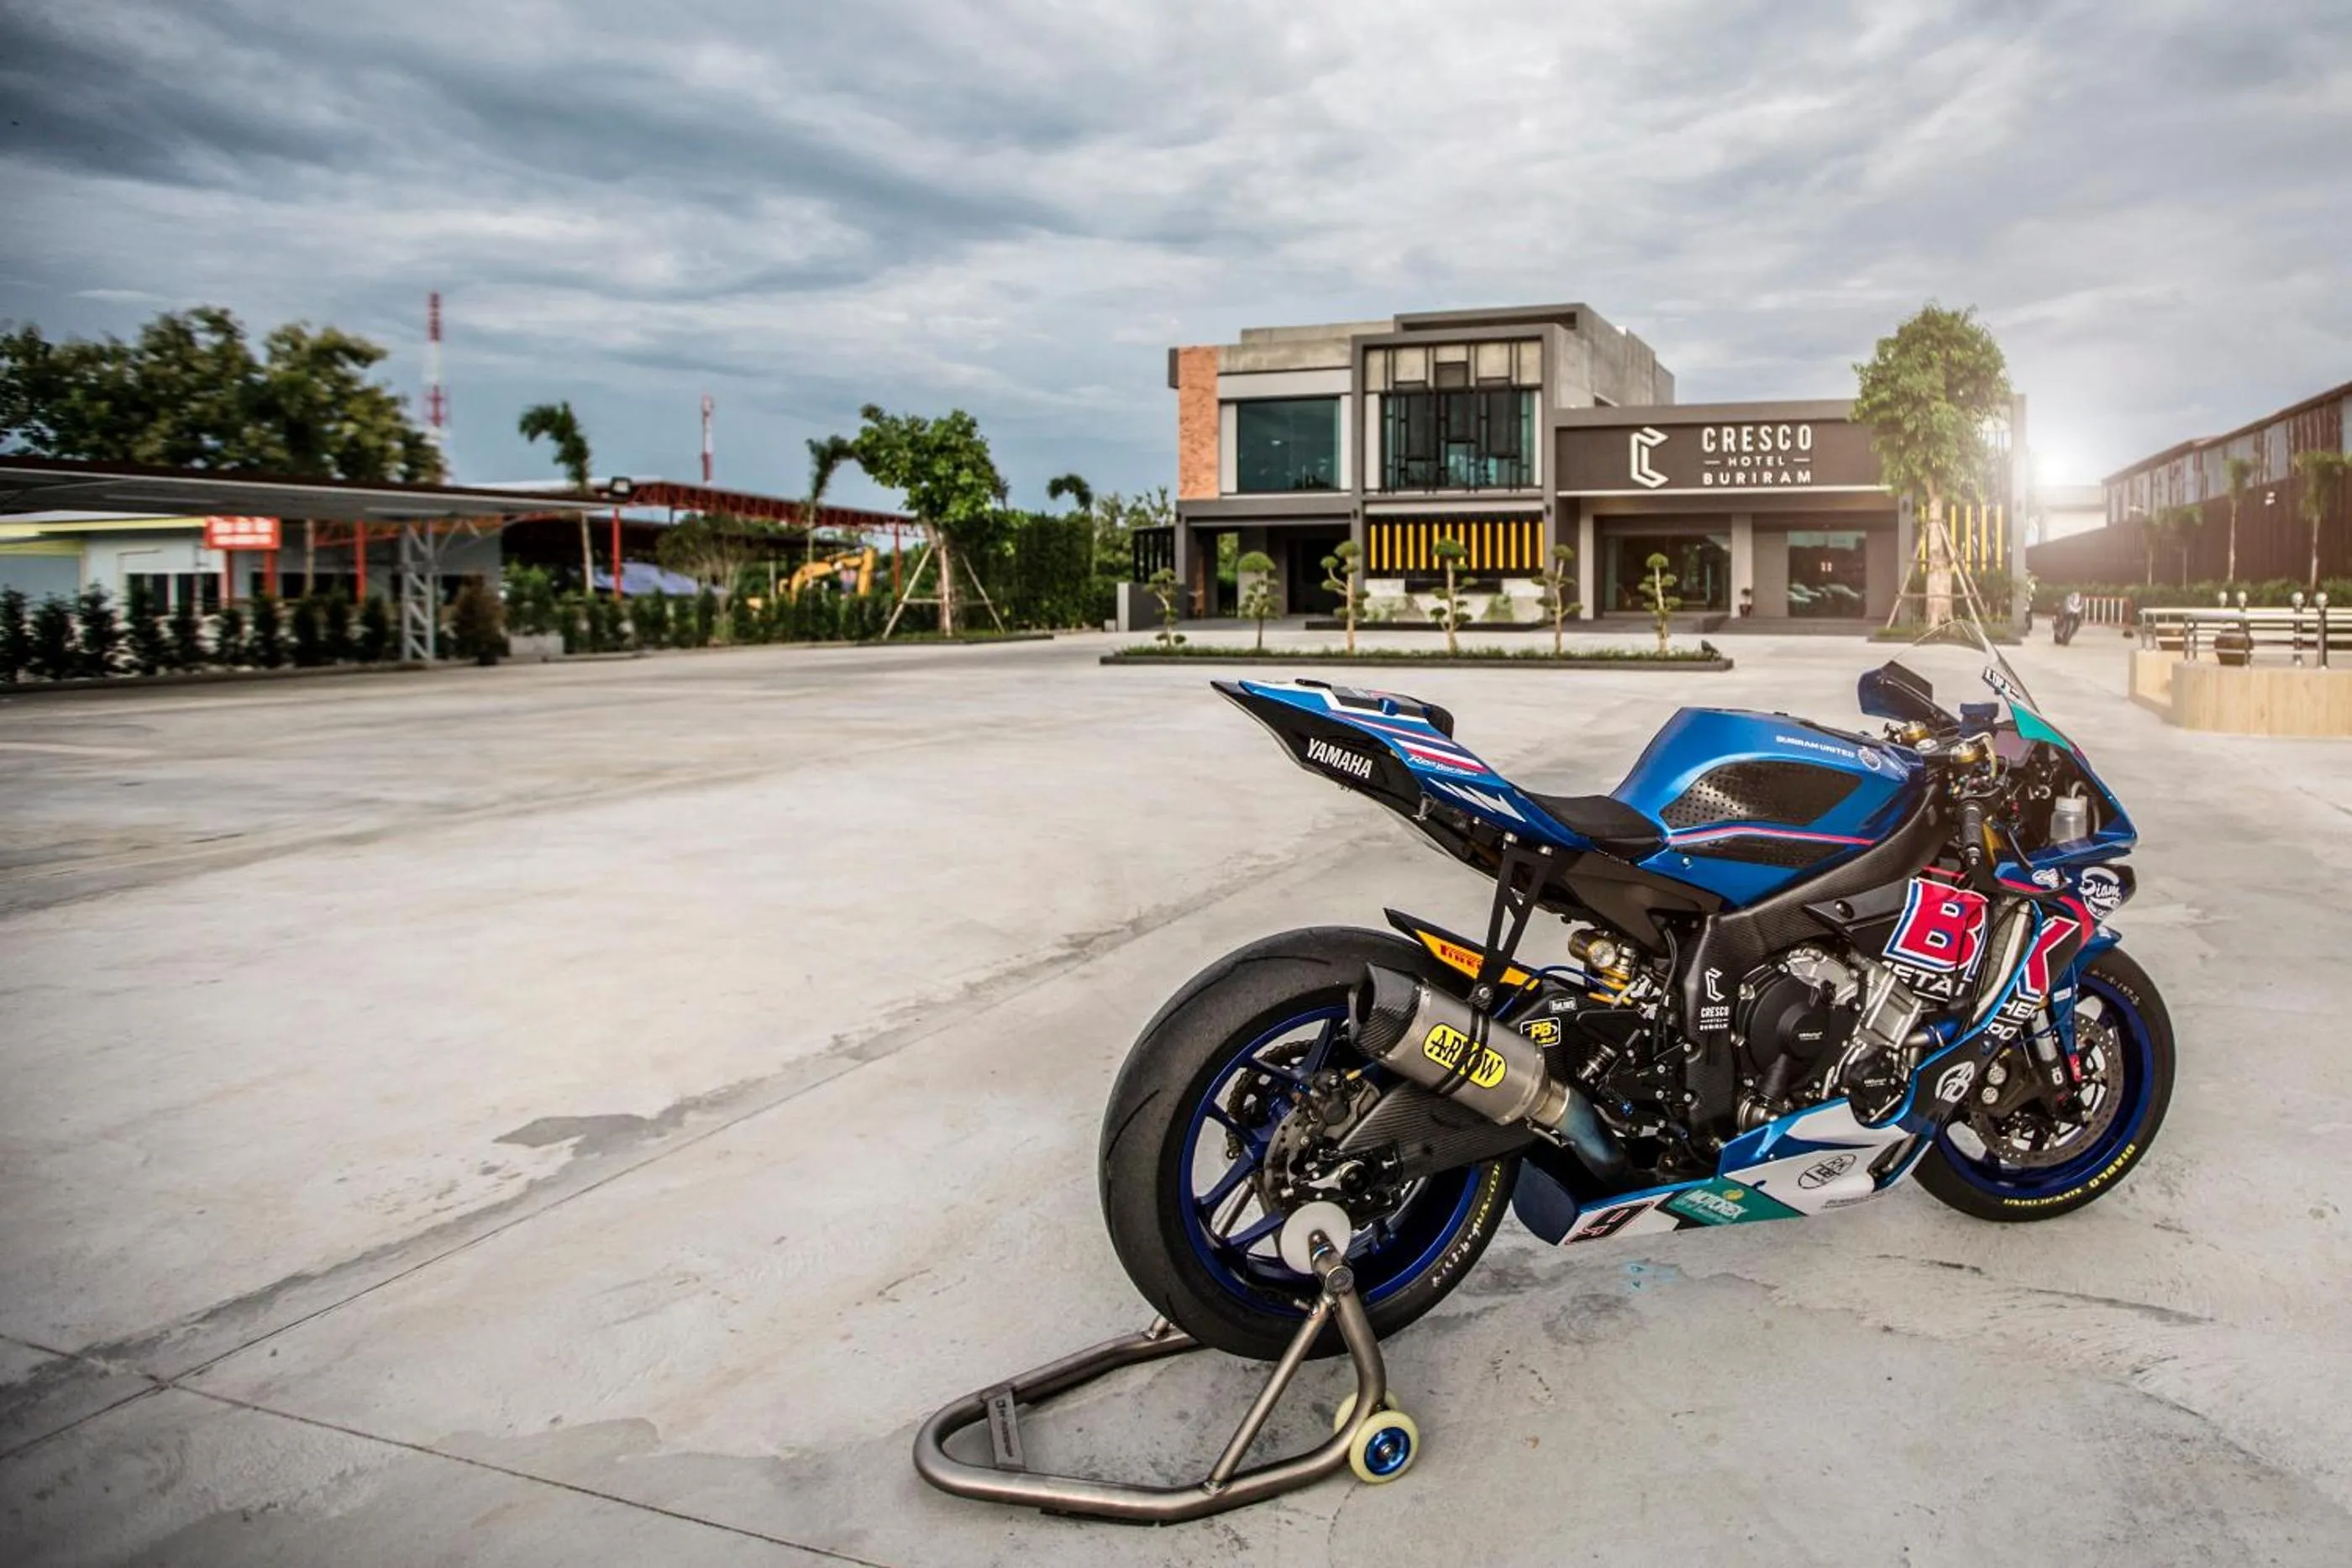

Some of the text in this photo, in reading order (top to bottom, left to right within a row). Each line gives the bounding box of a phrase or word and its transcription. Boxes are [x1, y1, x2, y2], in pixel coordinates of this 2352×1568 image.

[1702, 424, 1812, 454] CRESCO
[1728, 455, 1785, 467] HOTEL
[1703, 470, 1812, 485] BURIRAM
[1306, 737, 1373, 779] YAMAHA
[1428, 1030, 1502, 1081] ARW
